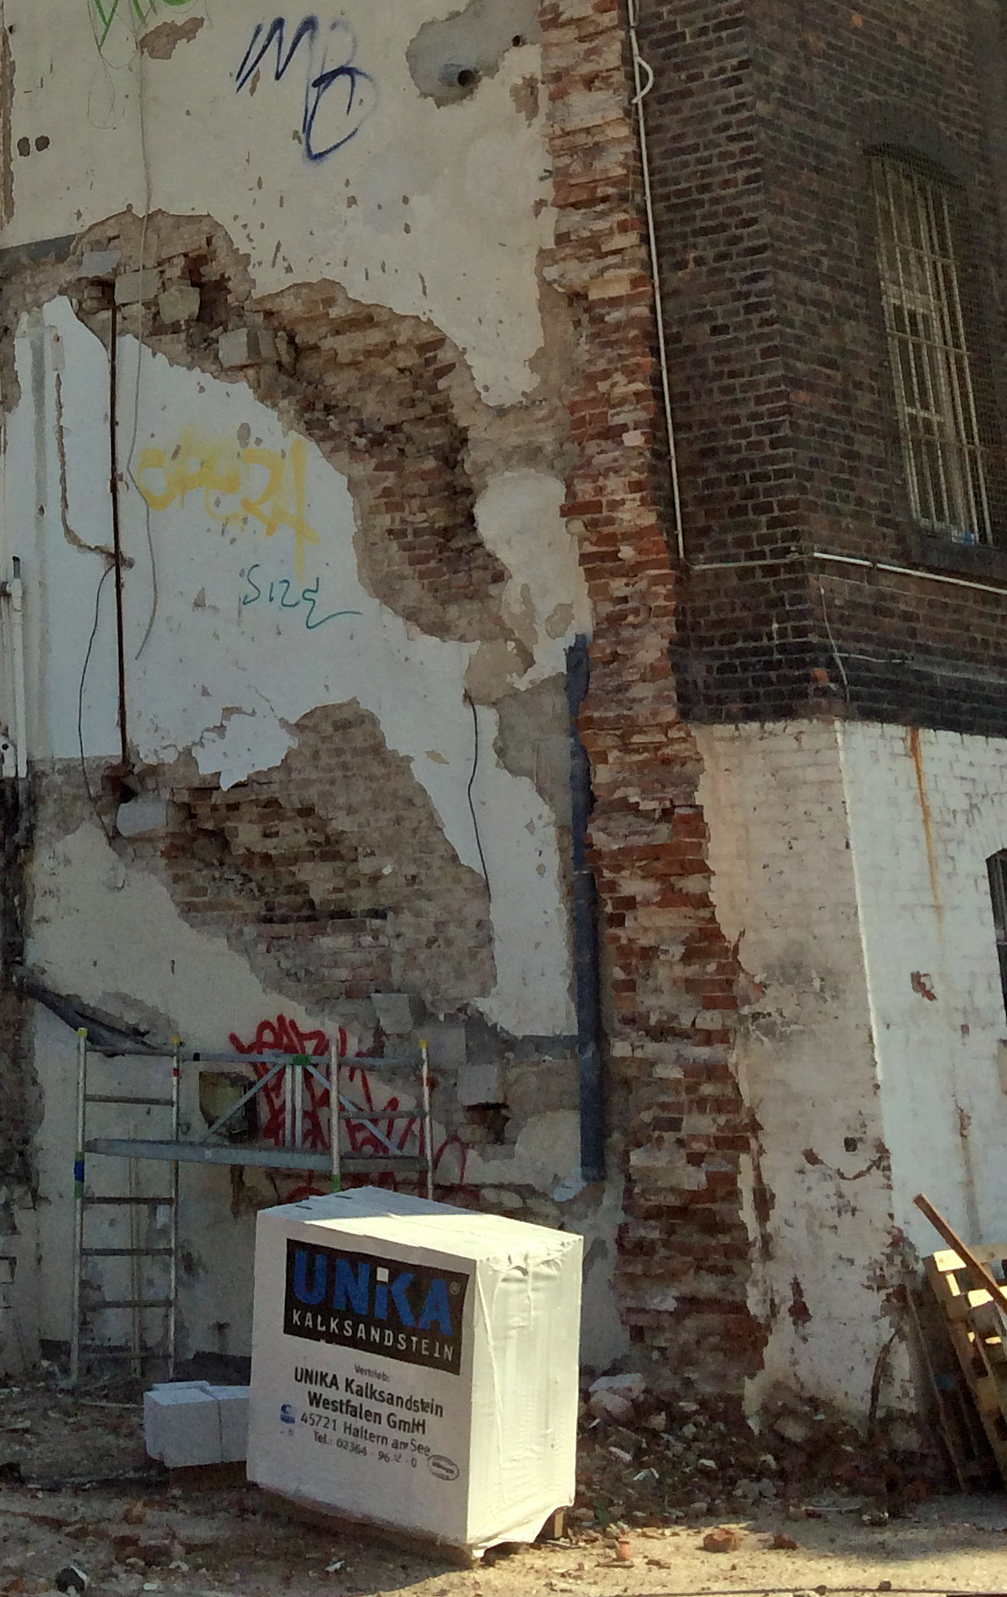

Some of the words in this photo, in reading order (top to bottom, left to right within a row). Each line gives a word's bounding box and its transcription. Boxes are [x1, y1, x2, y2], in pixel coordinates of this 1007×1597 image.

[292, 1308, 454, 1362] KALKSANDSTEIN
[294, 1366, 340, 1391] UNIKA
[345, 1377, 444, 1418] Kalksandstein
[307, 1390, 382, 1425] Westfalen
[300, 1412, 337, 1431] 45721
[343, 1421, 389, 1446] Haltern
[410, 1438, 431, 1457] See
